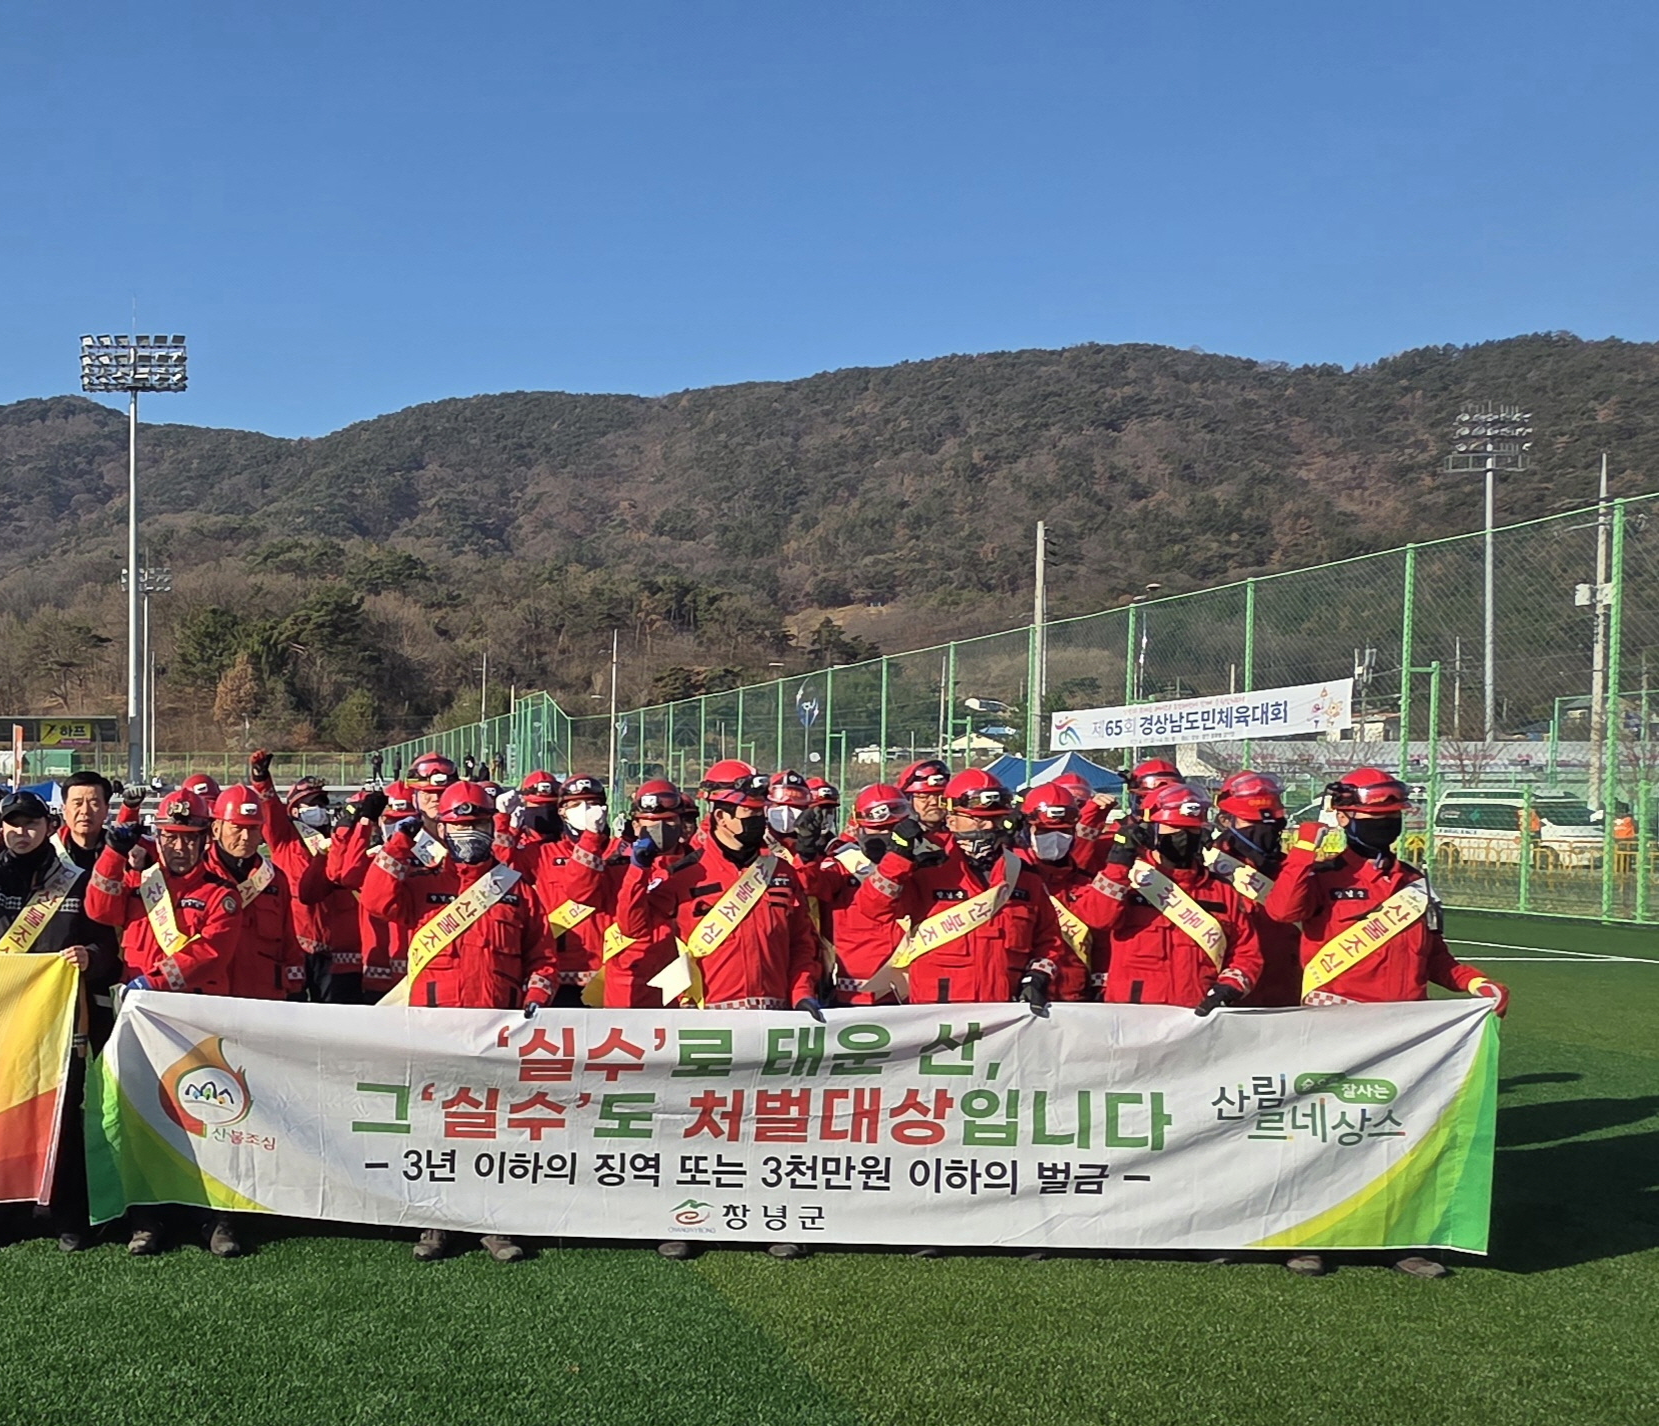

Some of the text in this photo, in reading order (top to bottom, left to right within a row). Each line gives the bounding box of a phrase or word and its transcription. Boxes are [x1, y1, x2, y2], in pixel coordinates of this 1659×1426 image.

[60, 725, 86, 737] 하프
[1091, 716, 1137, 739] 제65회
[1139, 700, 1288, 736] 경상남도민체육대회
[700, 862, 769, 945] 산불조심
[1319, 904, 1411, 974] 산불조심
[760, 1023, 892, 1077] 태운
[918, 1022, 1002, 1081] 산,
[1211, 1073, 1286, 1121] 산림
[1341, 1083, 1391, 1100] 잘사는
[211, 1126, 277, 1151] 산불조심
[682, 1086, 1173, 1151] 처벌대상입니다
[1247, 1097, 1406, 1147] 르네상스
[402, 1148, 457, 1184] 3년
[474, 1151, 578, 1186] 이하의
[593, 1152, 662, 1188] 징역
[675, 1153, 748, 1189] 또는
[760, 1154, 892, 1193] 3천만원
[908, 1158, 1019, 1195] 이하의
[1037, 1160, 1110, 1195] 벌금
